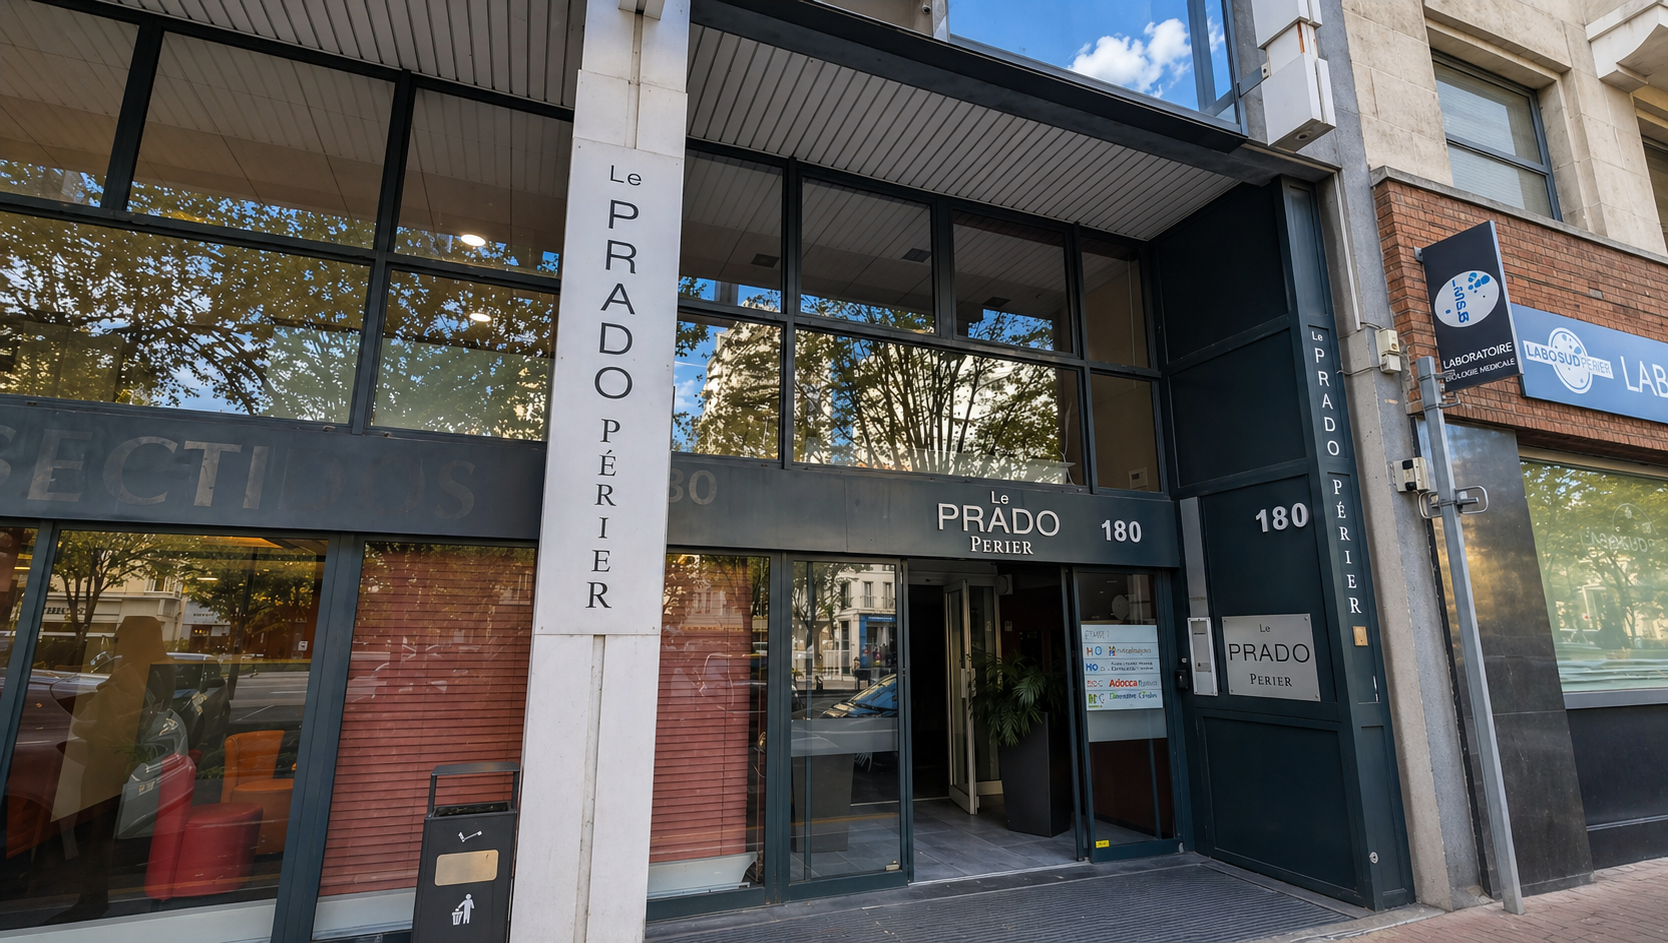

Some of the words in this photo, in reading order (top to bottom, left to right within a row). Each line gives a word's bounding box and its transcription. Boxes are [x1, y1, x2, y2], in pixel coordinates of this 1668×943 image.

[610, 164, 642, 187] Le
[594, 199, 640, 400] PRADO
[1310, 330, 1323, 342] Le
[1442, 341, 1513, 369] LABORATOIRE
[1479, 357, 1516, 375] MEDICALE
[1314, 347, 1340, 456] PRADO
[990, 490, 1009, 505] Le
[585, 418, 622, 609] PÉRIER
[937, 502, 1060, 537] PRADO
[1255, 502, 1310, 533] 180
[1101, 519, 1142, 543] 180
[969, 535, 1034, 555] PERIER
[1332, 479, 1362, 614] PÉRIER
[1259, 624, 1271, 633] Le
[1228, 643, 1310, 663] PRADO
[1250, 673, 1292, 687] PERIER
